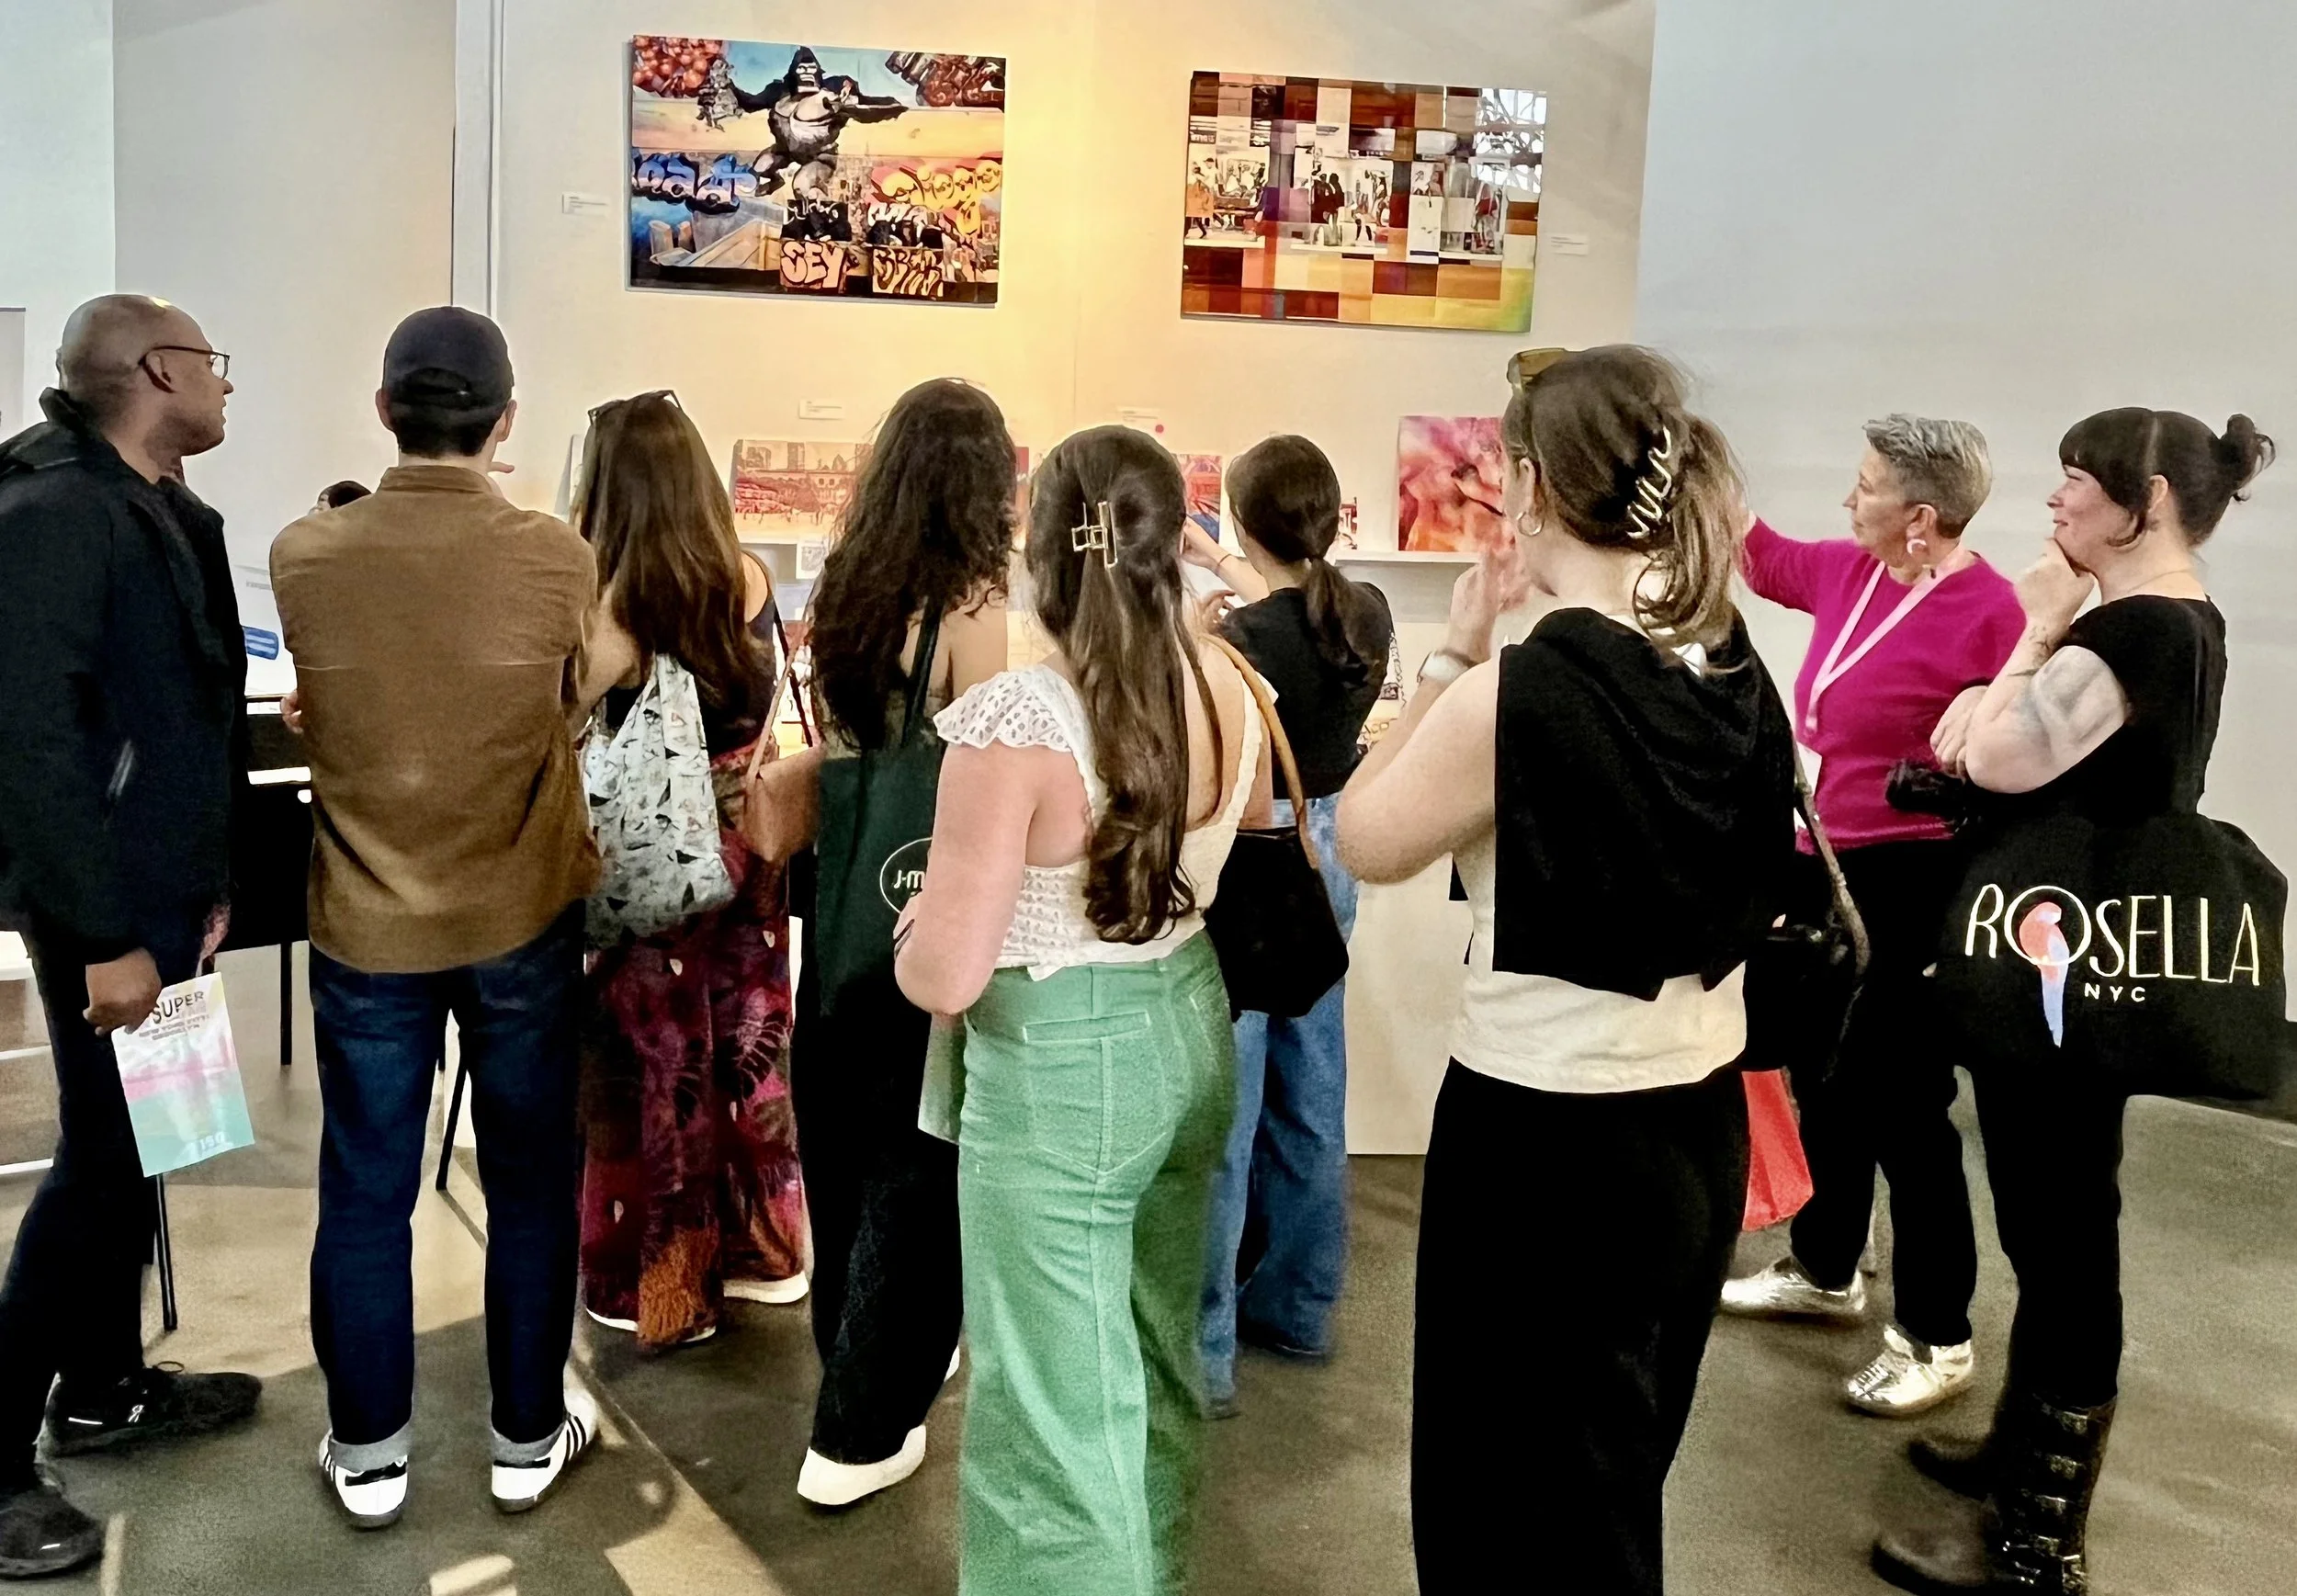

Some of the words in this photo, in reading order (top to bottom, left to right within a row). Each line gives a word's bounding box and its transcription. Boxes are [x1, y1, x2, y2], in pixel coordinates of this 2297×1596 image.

[1965, 883, 2260, 986] ROSELLA
[153, 991, 204, 1024] SUPER
[2084, 982, 2145, 1002] NYC
